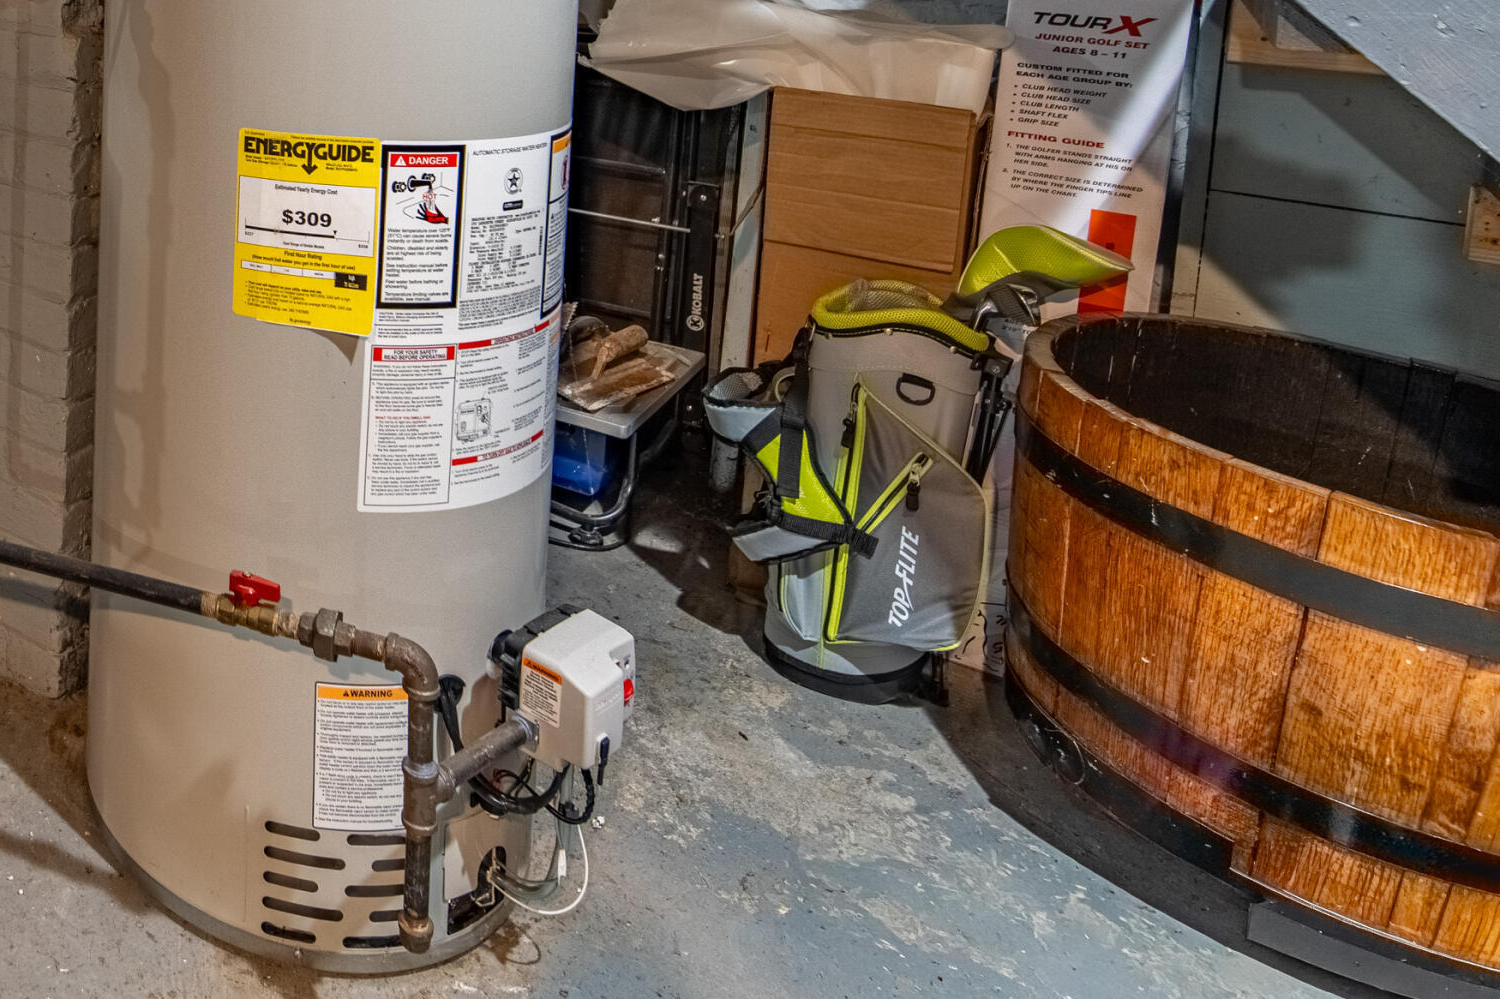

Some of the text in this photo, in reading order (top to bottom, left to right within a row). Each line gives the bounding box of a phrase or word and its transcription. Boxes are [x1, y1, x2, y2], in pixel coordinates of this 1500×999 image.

[1035, 33, 1150, 49] JUNIOR GOLF SET
[1052, 46, 1086, 55] AGES
[1017, 62, 1062, 71] CUSTOM
[1066, 67, 1103, 76] FITTED
[1073, 76, 1112, 85] GROUP
[1022, 83, 1045, 91] CLUB
[1073, 88, 1107, 98] WEIGHT
[1046, 94, 1070, 102] HEAD
[1045, 103, 1080, 112] LENGTH
[1007, 130, 1105, 148] FITTING GUIDE
[244, 136, 374, 164] ENERGYGUIDE
[1031, 146, 1061, 154] GOLFER
[1063, 150, 1092, 159] STANDS
[1094, 154, 1133, 164] STRAIGHT
[409, 157, 448, 165] DANGER
[1031, 160, 1049, 168] SIDE.
[1057, 157, 1092, 166] HANGING
[1022, 178, 1048, 187] WHERE
[1065, 184, 1094, 192] FINGER
[1114, 191, 1132, 199] LINE
[1028, 171, 1063, 180] CORRECT
[1092, 180, 1143, 192] DETERMINED
[275, 184, 296, 192] Estimated
[297, 185, 310, 193] Yearly
[311, 187, 326, 195] Energy
[1035, 186, 1049, 194] THE
[1051, 189, 1077, 198] CHART.
[282, 209, 332, 227] $309
[691, 273, 703, 315] KOBALT
